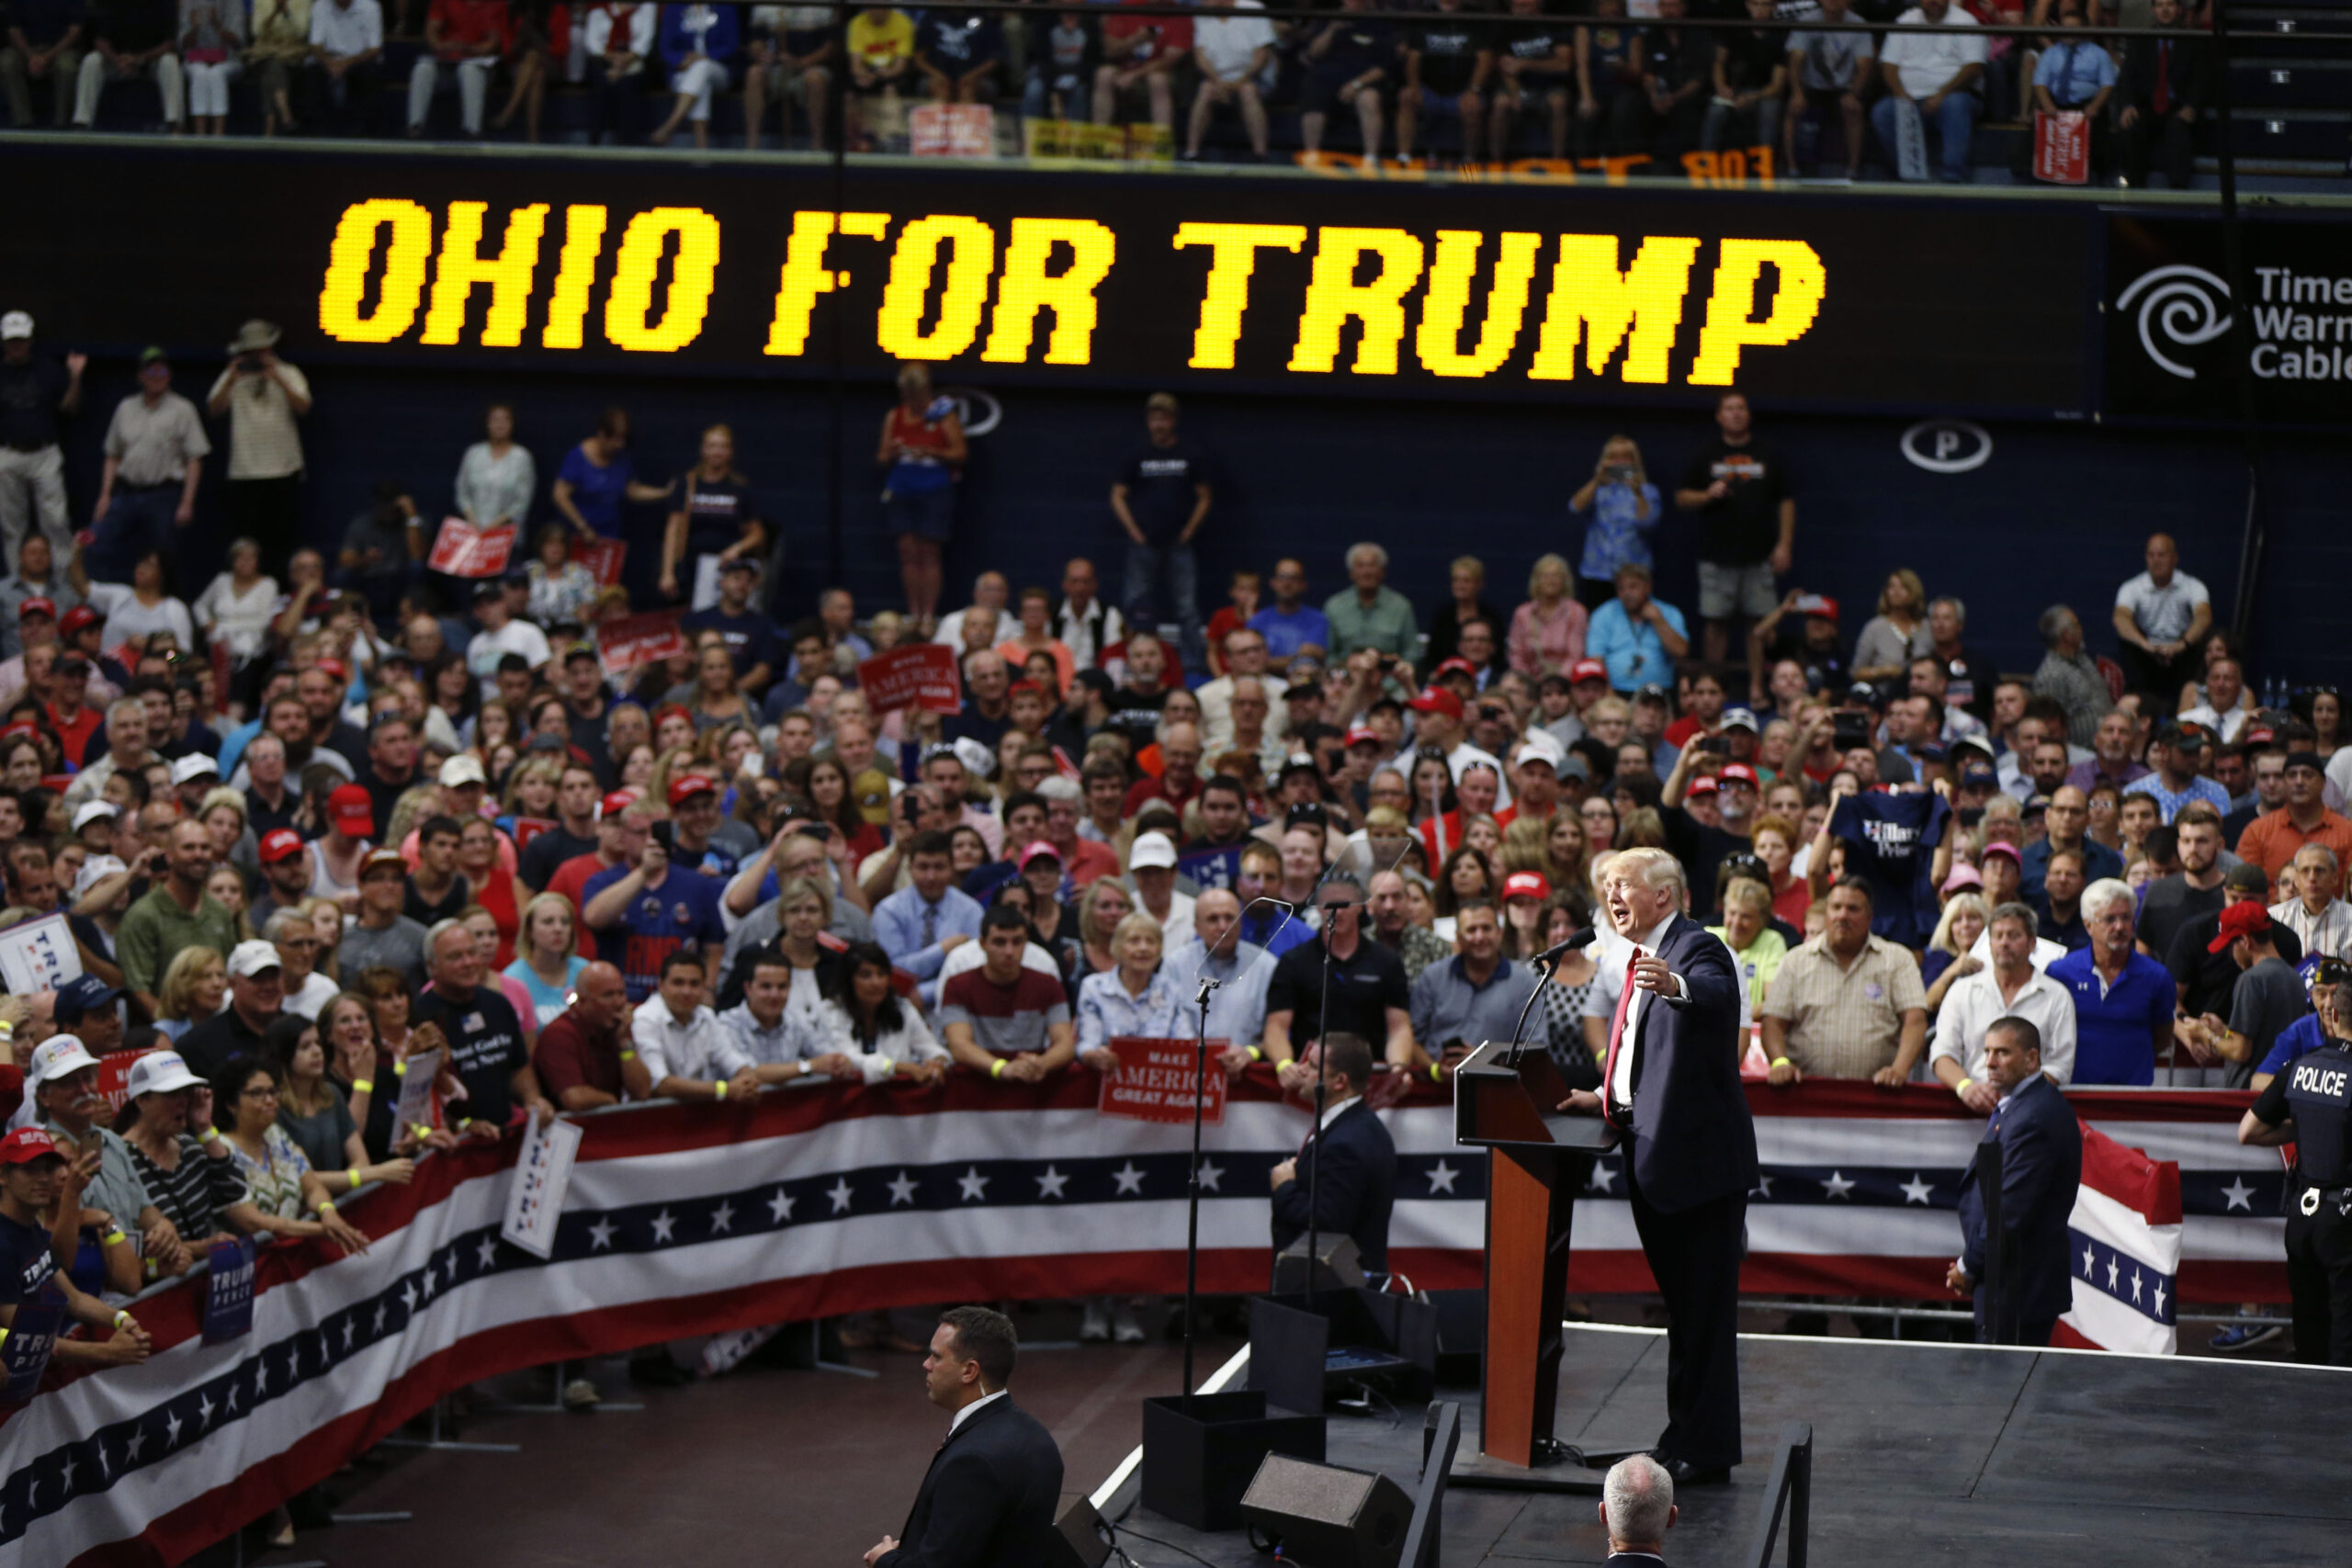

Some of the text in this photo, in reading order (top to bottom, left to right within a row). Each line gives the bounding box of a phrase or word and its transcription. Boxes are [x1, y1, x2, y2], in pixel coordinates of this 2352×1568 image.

[319, 198, 1826, 386] OHIO FOR TRUMP
[2255, 267, 2352, 304] Time
[36, 930, 64, 991] TRU
[1148, 1051, 1189, 1066] MAKE
[2292, 1066, 2347, 1097] POLICE
[1112, 1088, 1214, 1108] GREAT AGAN
[15, 1334, 55, 1352] TRU
